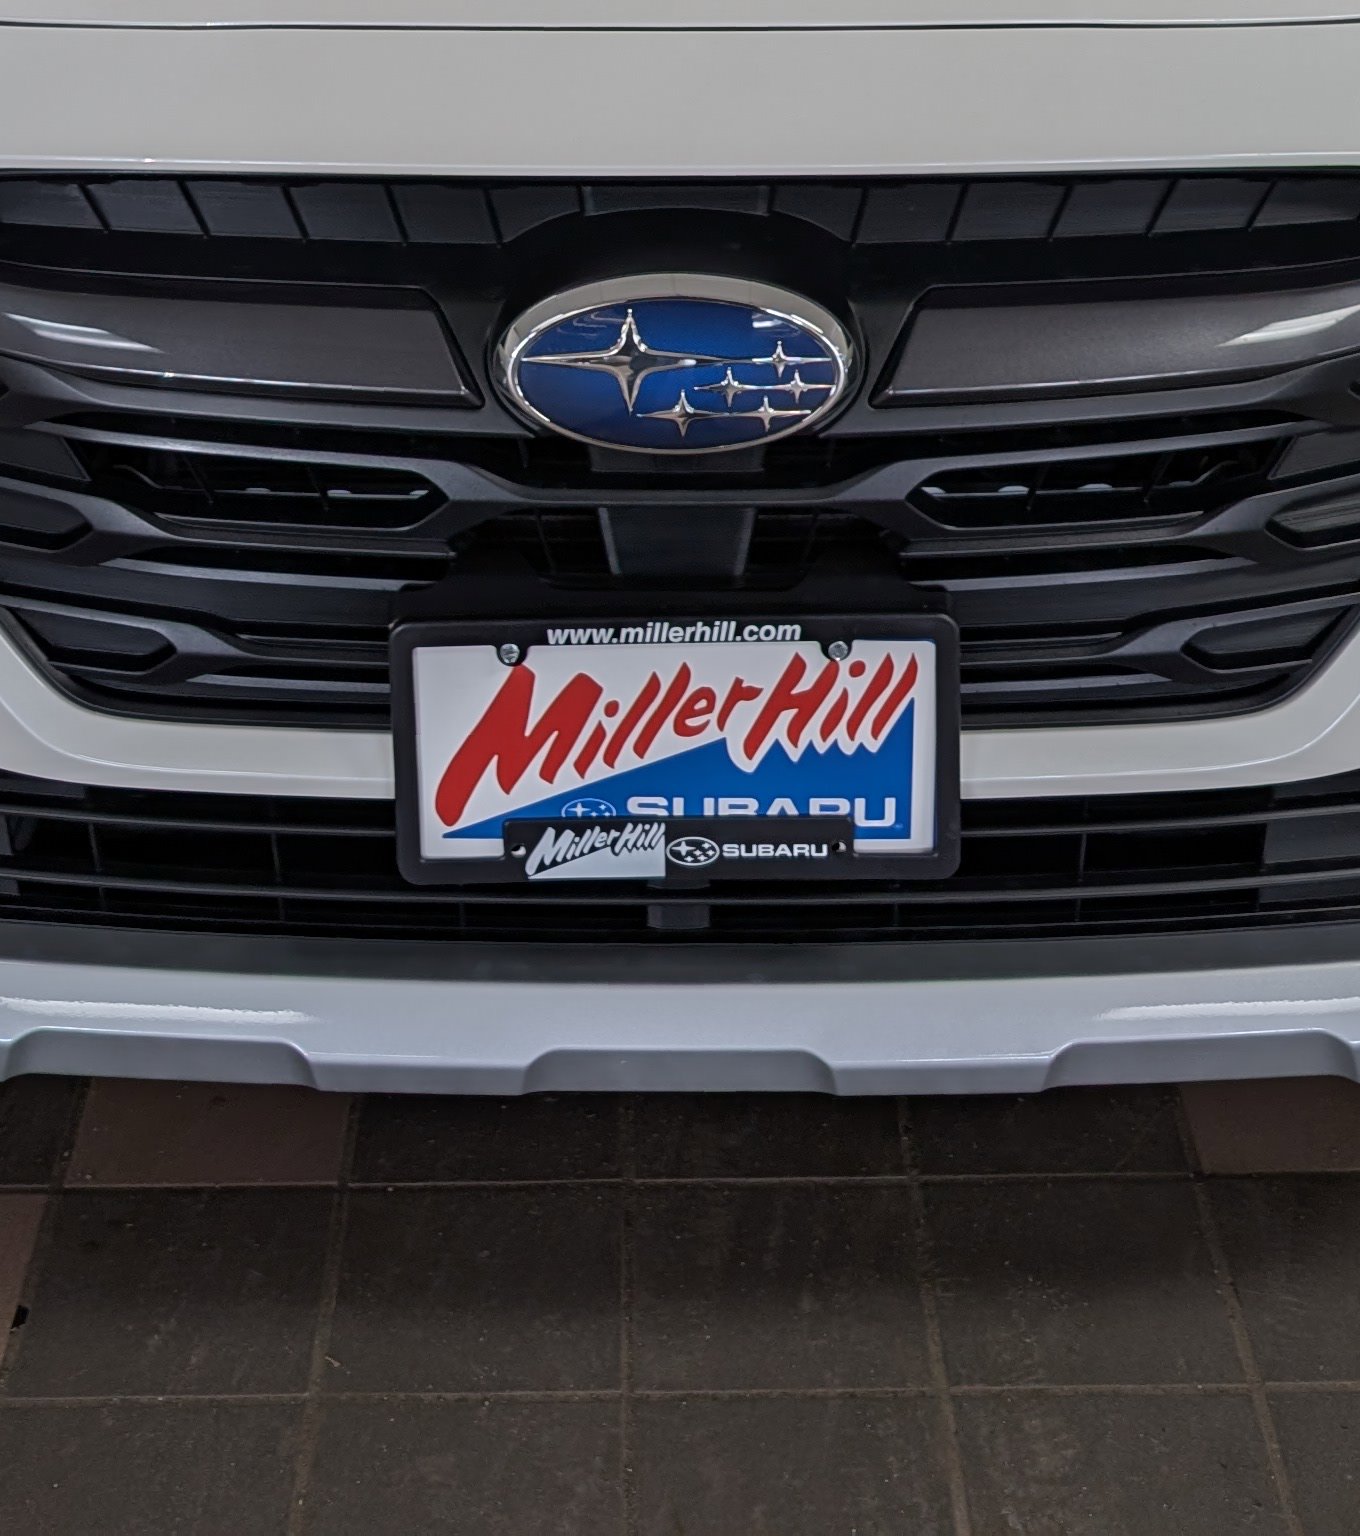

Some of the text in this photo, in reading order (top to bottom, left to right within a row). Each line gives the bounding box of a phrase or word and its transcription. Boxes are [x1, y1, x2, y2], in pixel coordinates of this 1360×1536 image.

[547, 621, 801, 645] www.millerhill.com
[435, 652, 918, 827] Miller Hill
[525, 822, 827, 876] Miller Hill SUBARU
